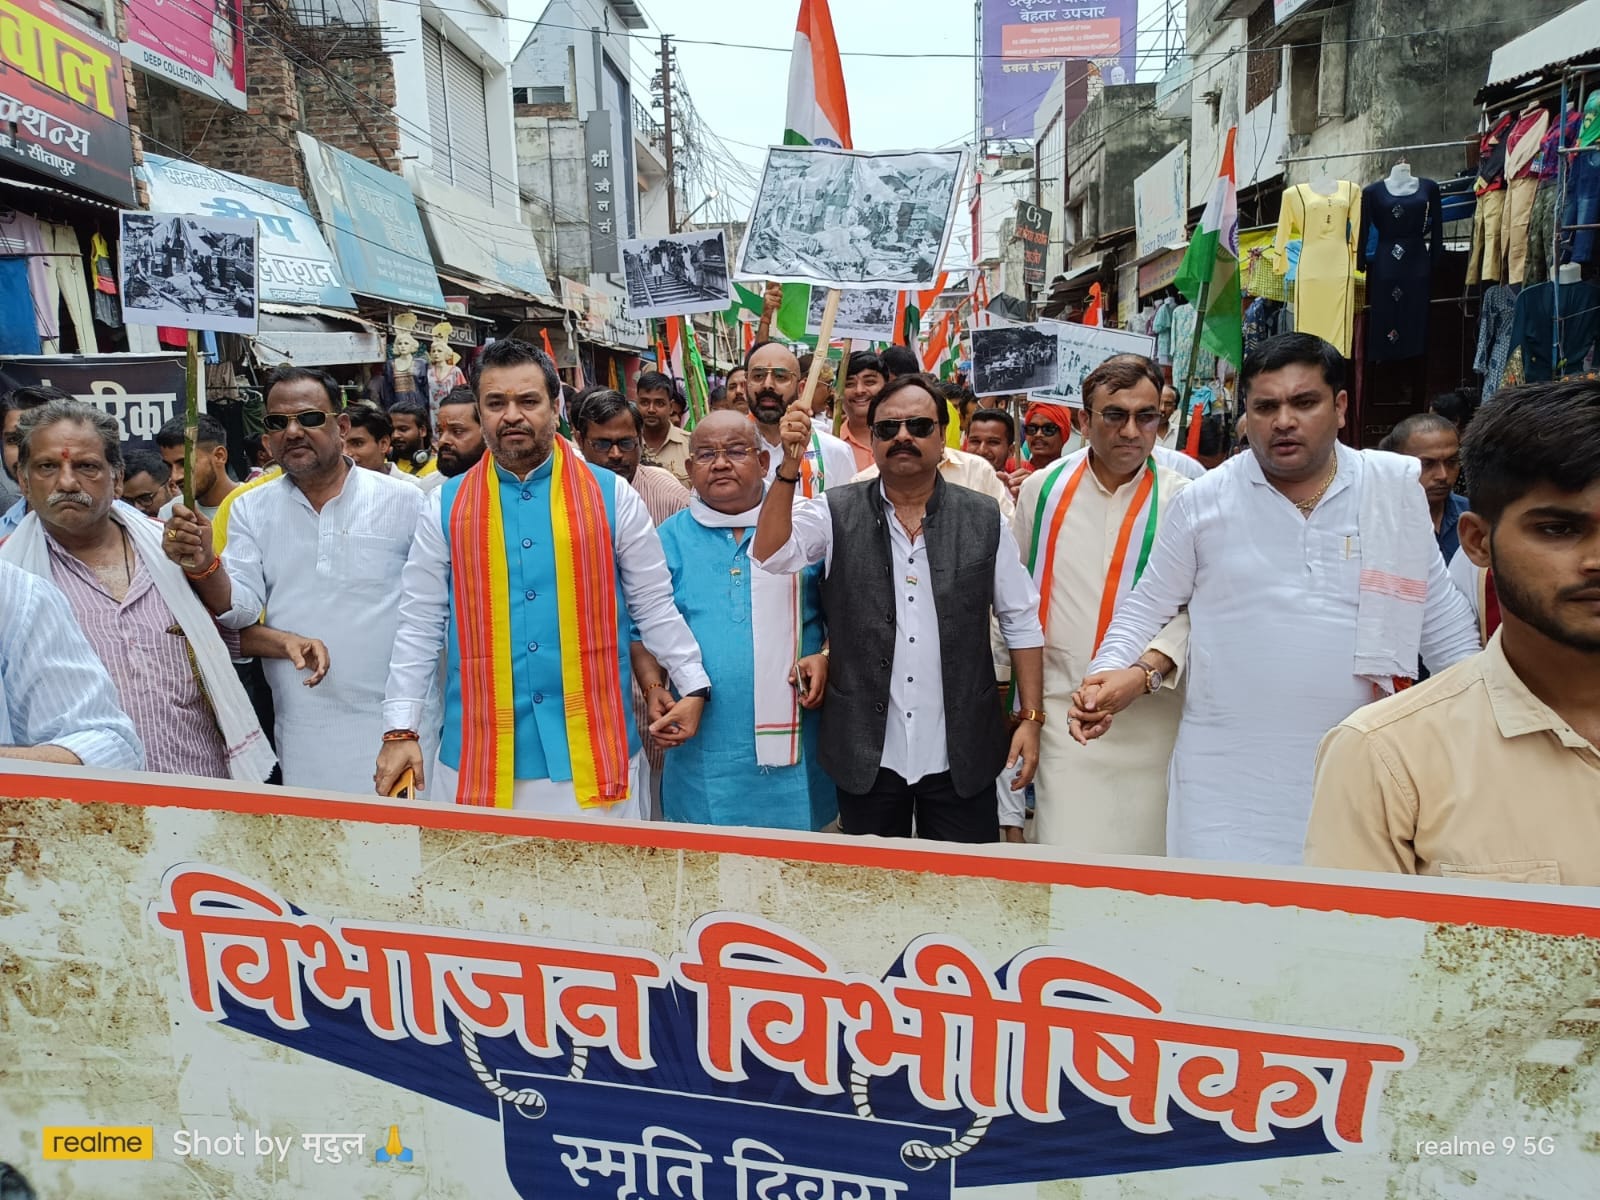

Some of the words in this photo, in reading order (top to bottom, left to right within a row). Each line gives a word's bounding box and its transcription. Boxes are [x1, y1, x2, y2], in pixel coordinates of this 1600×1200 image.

[1019, 9, 1056, 23] बेहतर
[1062, 6, 1106, 20] उपचार
[143, 51, 161, 67] DEEP
[163, 61, 203, 87] COLLECTION
[27, 144, 76, 176] सीतापुर
[591, 149, 610, 168] श्री
[157, 871, 661, 1061] विभाजन
[680, 921, 1404, 1144] विभीषिका
[552, 1126, 713, 1200] स्मृति
